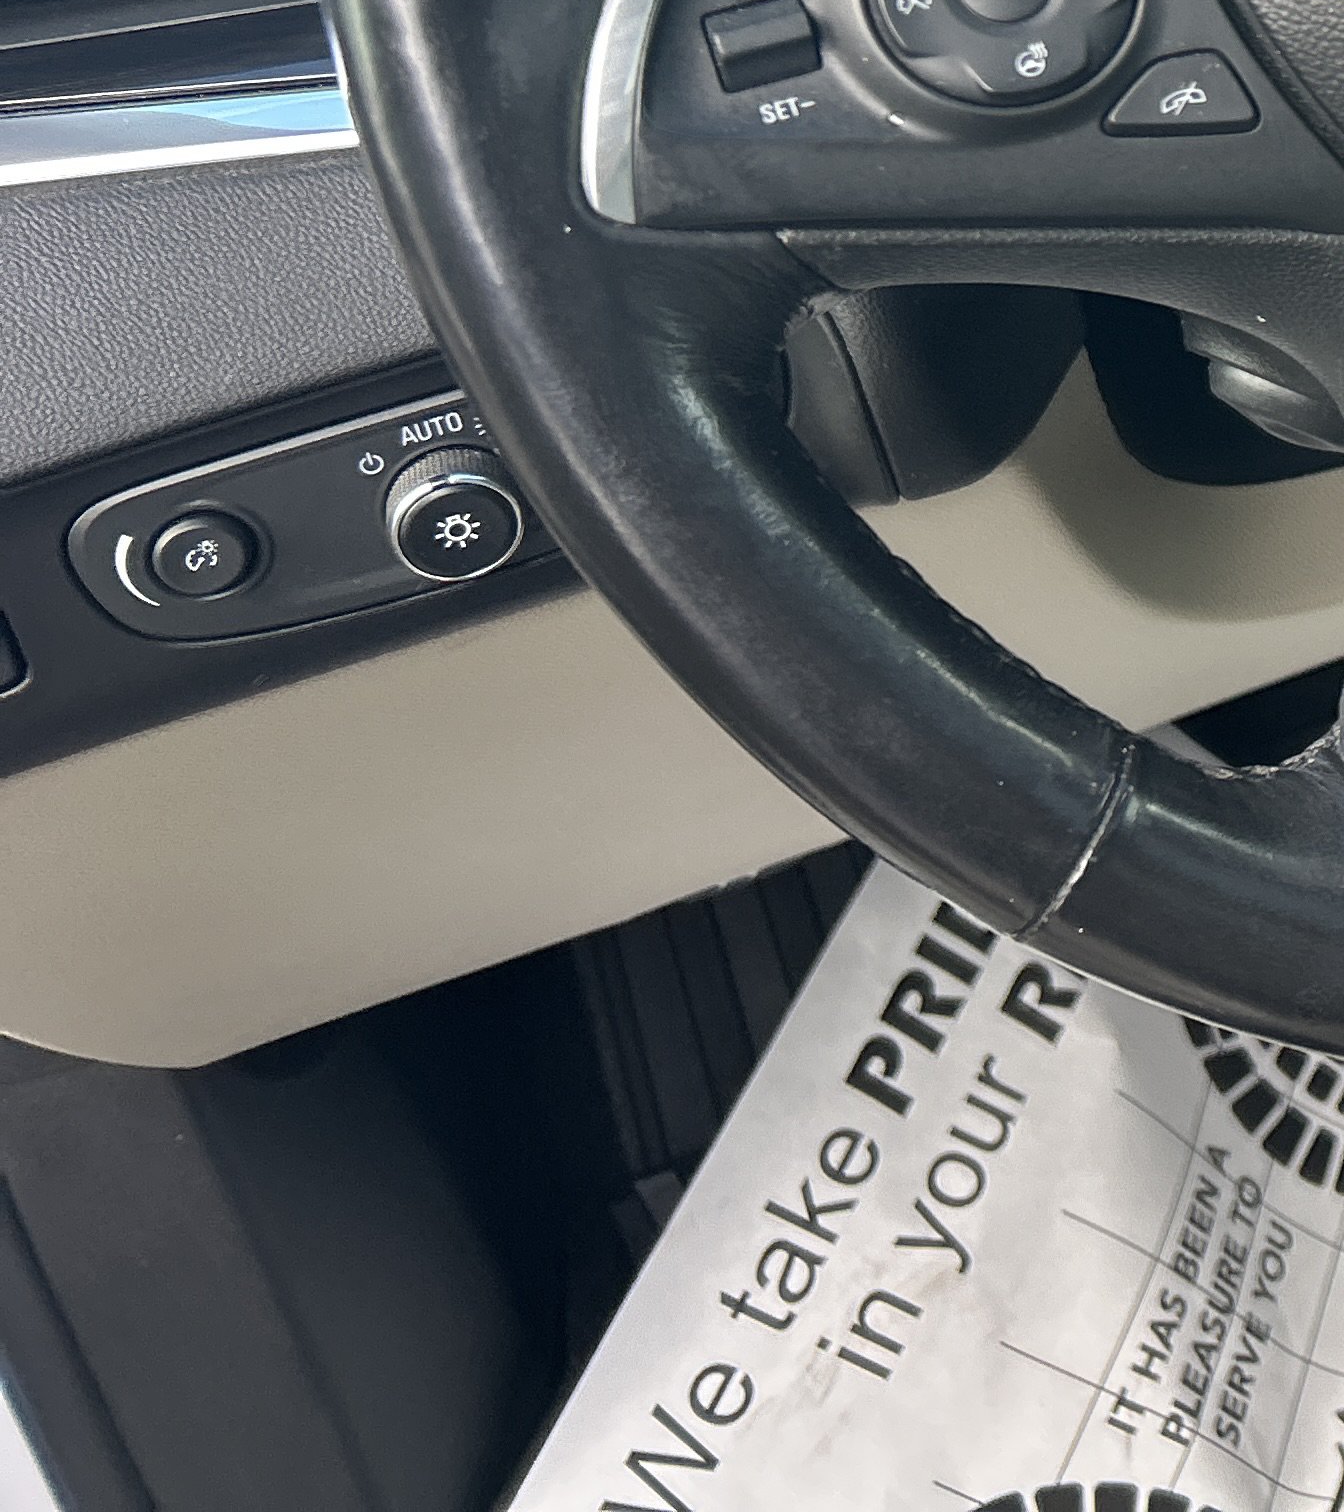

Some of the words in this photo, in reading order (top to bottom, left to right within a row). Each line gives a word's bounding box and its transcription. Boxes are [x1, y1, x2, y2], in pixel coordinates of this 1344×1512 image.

[401, 411, 463, 447] AUTO
[719, 1125, 880, 1332] take
[816, 1288, 922, 1380] in
[895, 1055, 1028, 1274] your
[1001, 960, 1088, 1048] R
[1107, 1387, 1146, 1436] IT
[1131, 1289, 1188, 1384] HAS
[1173, 1174, 1221, 1283] BEEN
[1205, 1144, 1231, 1176] A
[1160, 1235, 1248, 1447] PLEASURE
[1231, 1175, 1262, 1230] TO
[1214, 1312, 1273, 1448] SERVE
[1254, 1220, 1294, 1305] YOU
